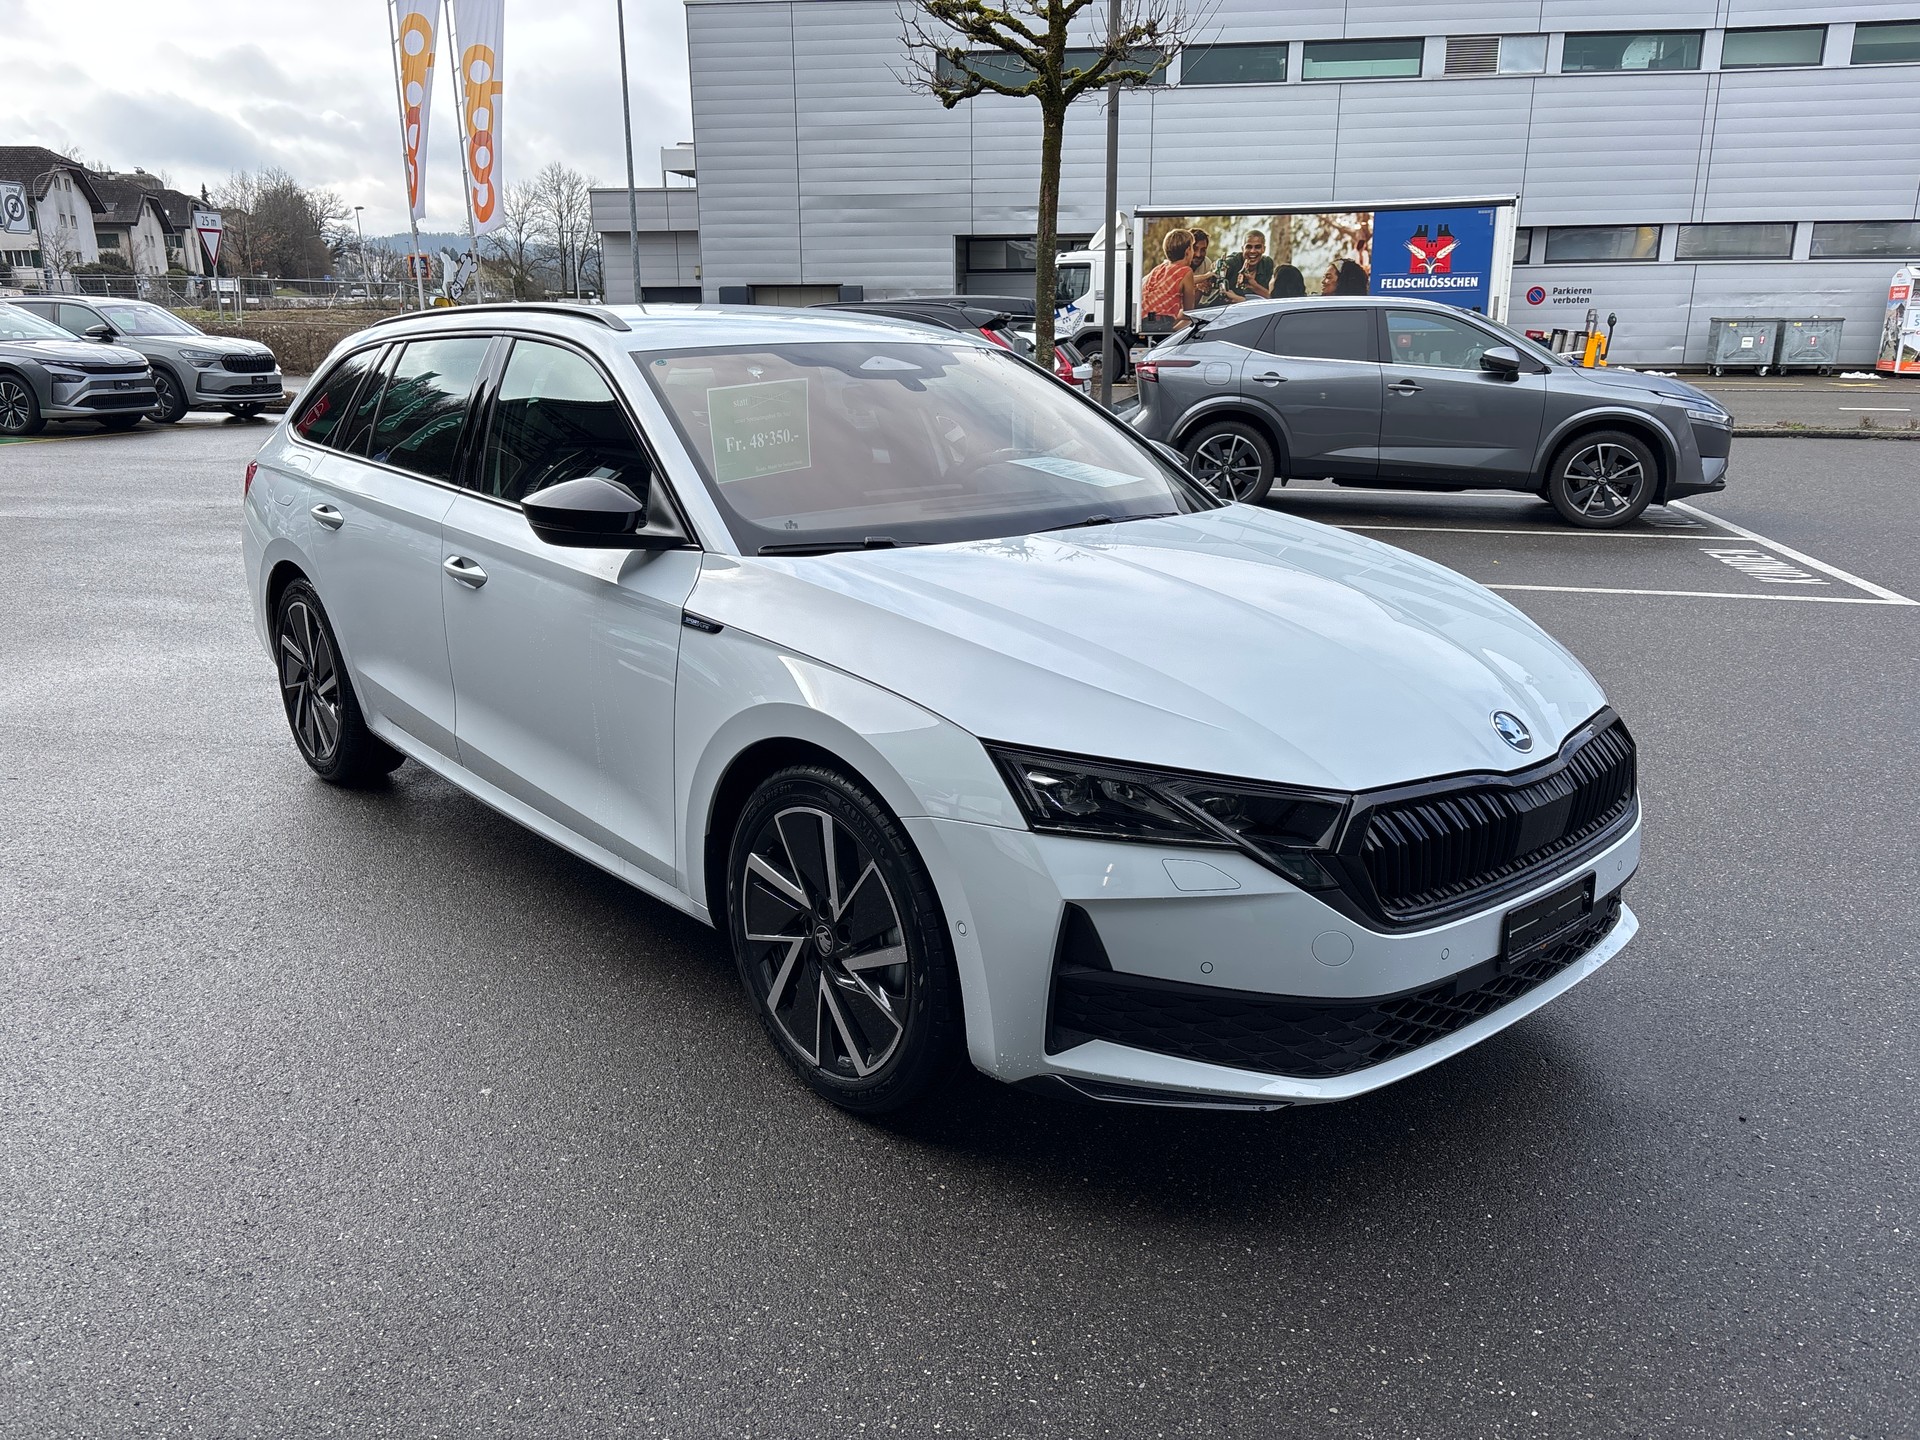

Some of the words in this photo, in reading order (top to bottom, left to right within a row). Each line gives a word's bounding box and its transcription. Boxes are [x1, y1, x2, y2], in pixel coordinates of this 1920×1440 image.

[462, 43, 503, 223] coop
[10, 201, 19, 213] 30
[201, 215, 210, 227] 25
[211, 218, 217, 227] m
[1380, 275, 1479, 289] FELDSCHLÖSSCHEN
[1552, 287, 1592, 295] Parkieren
[1552, 296, 1590, 304] verboten
[725, 437, 746, 453] Fr.
